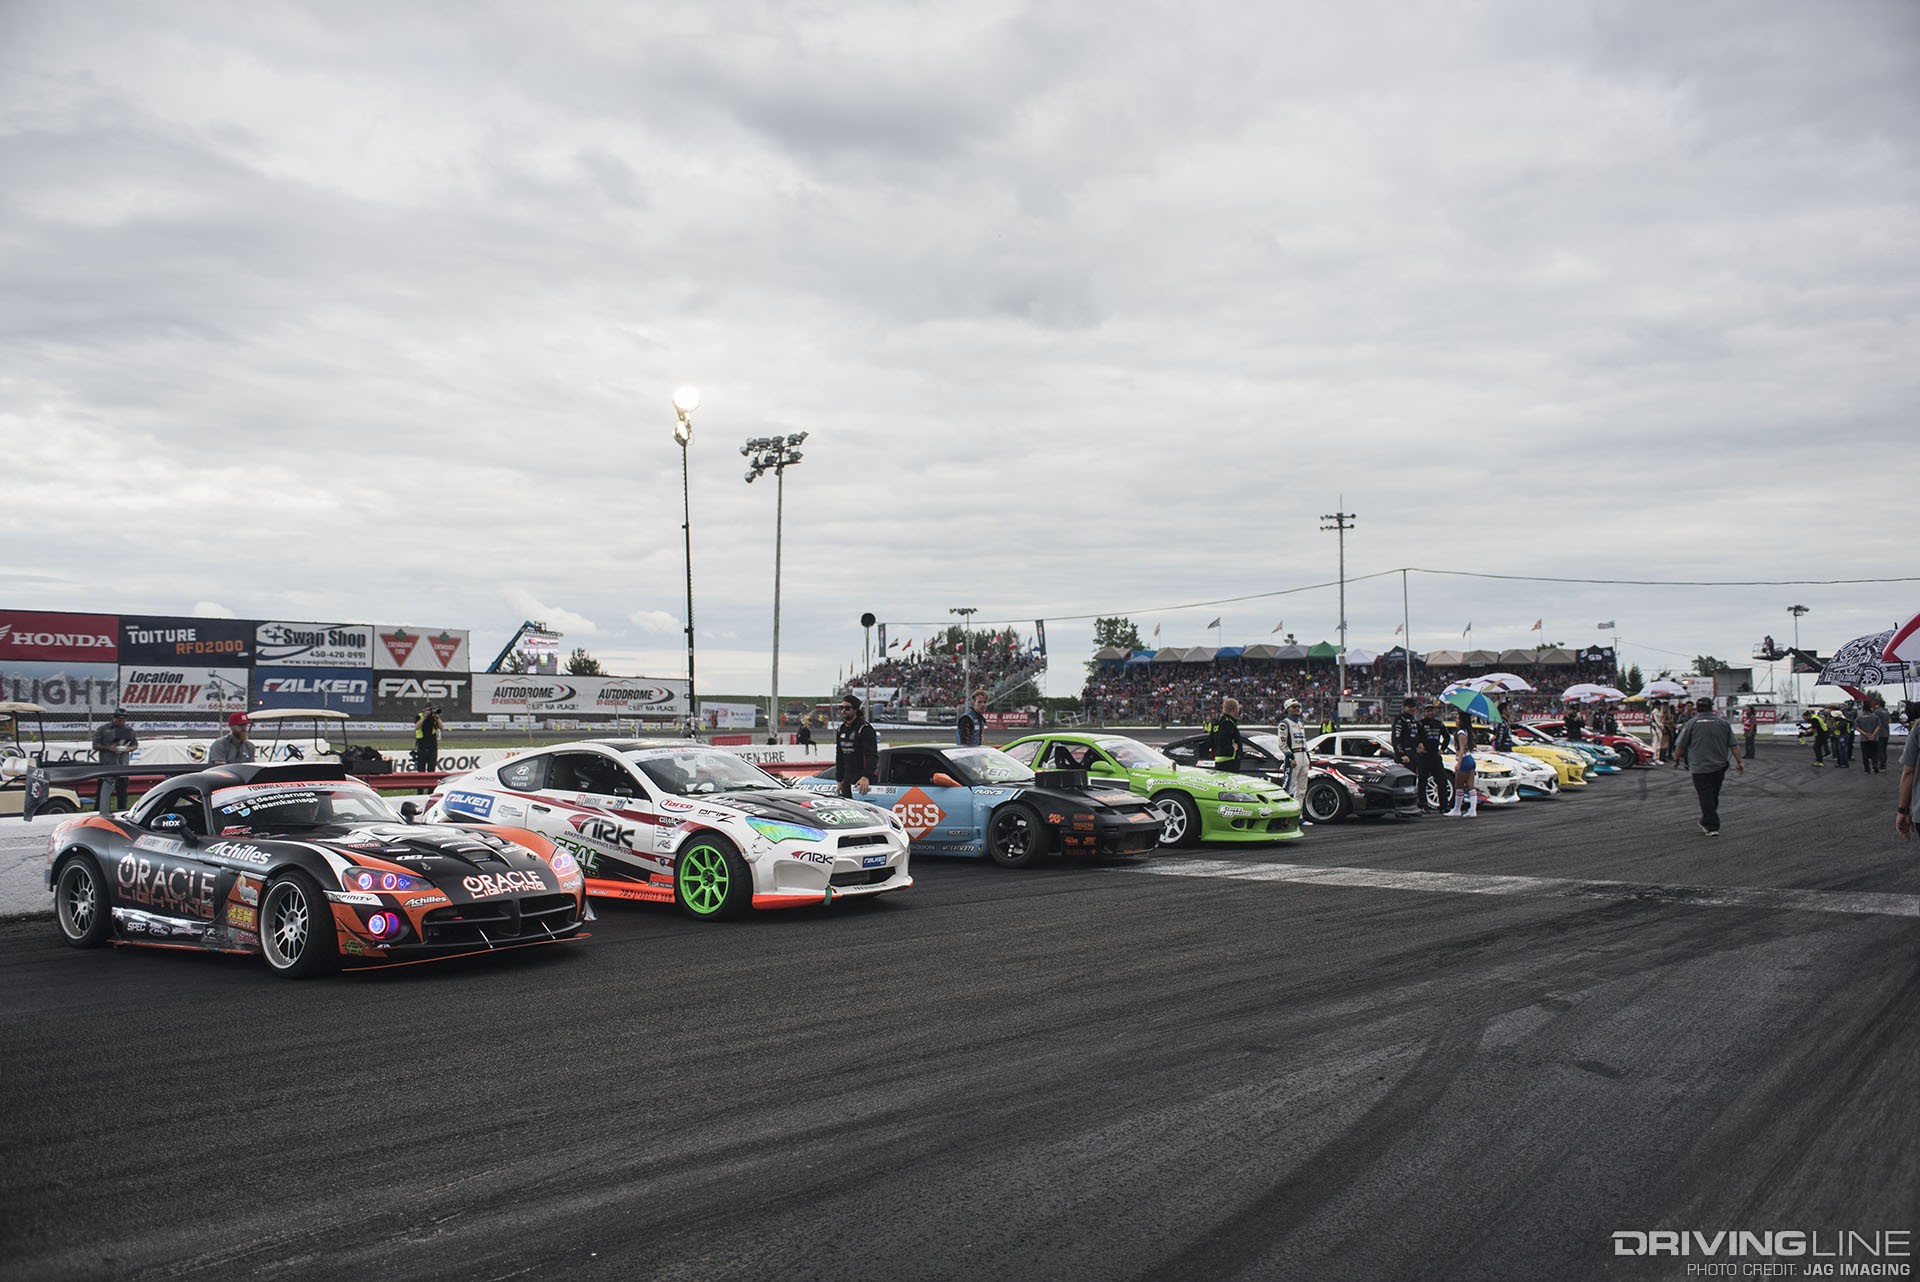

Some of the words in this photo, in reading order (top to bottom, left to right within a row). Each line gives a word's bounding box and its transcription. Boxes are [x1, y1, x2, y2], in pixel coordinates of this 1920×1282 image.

[11, 632, 116, 648] HONDA
[128, 629, 196, 644] TOITURE
[284, 629, 325, 649] Swap
[328, 630, 366, 649] Shop
[176, 640, 243, 655] RFD2000
[310, 651, 366, 659] 450-420-0991
[129, 671, 184, 684] Location
[263, 678, 368, 694] FALKEN
[378, 678, 467, 699] FAST
[494, 686, 555, 699] AUTODROME
[121, 684, 202, 704] RAVARY
[342, 695, 366, 703] TIRES
[598, 688, 655, 700] AUTODROME
[763, 750, 785, 763] TIRE
[447, 793, 491, 808] FALKEN
[663, 799, 695, 811] Torco
[891, 803, 940, 827] 959
[162, 820, 181, 828] HDX
[578, 817, 636, 849] ARK
[205, 841, 272, 865] Achilles
[800, 851, 834, 865] ARK
[117, 852, 217, 906] ORACLE
[462, 870, 541, 892] ORACLE
[471, 880, 547, 899] LIGHTING
[117, 886, 215, 920] LIGHTING
[404, 895, 448, 907] Achilles
[126, 921, 147, 932] SPEC
